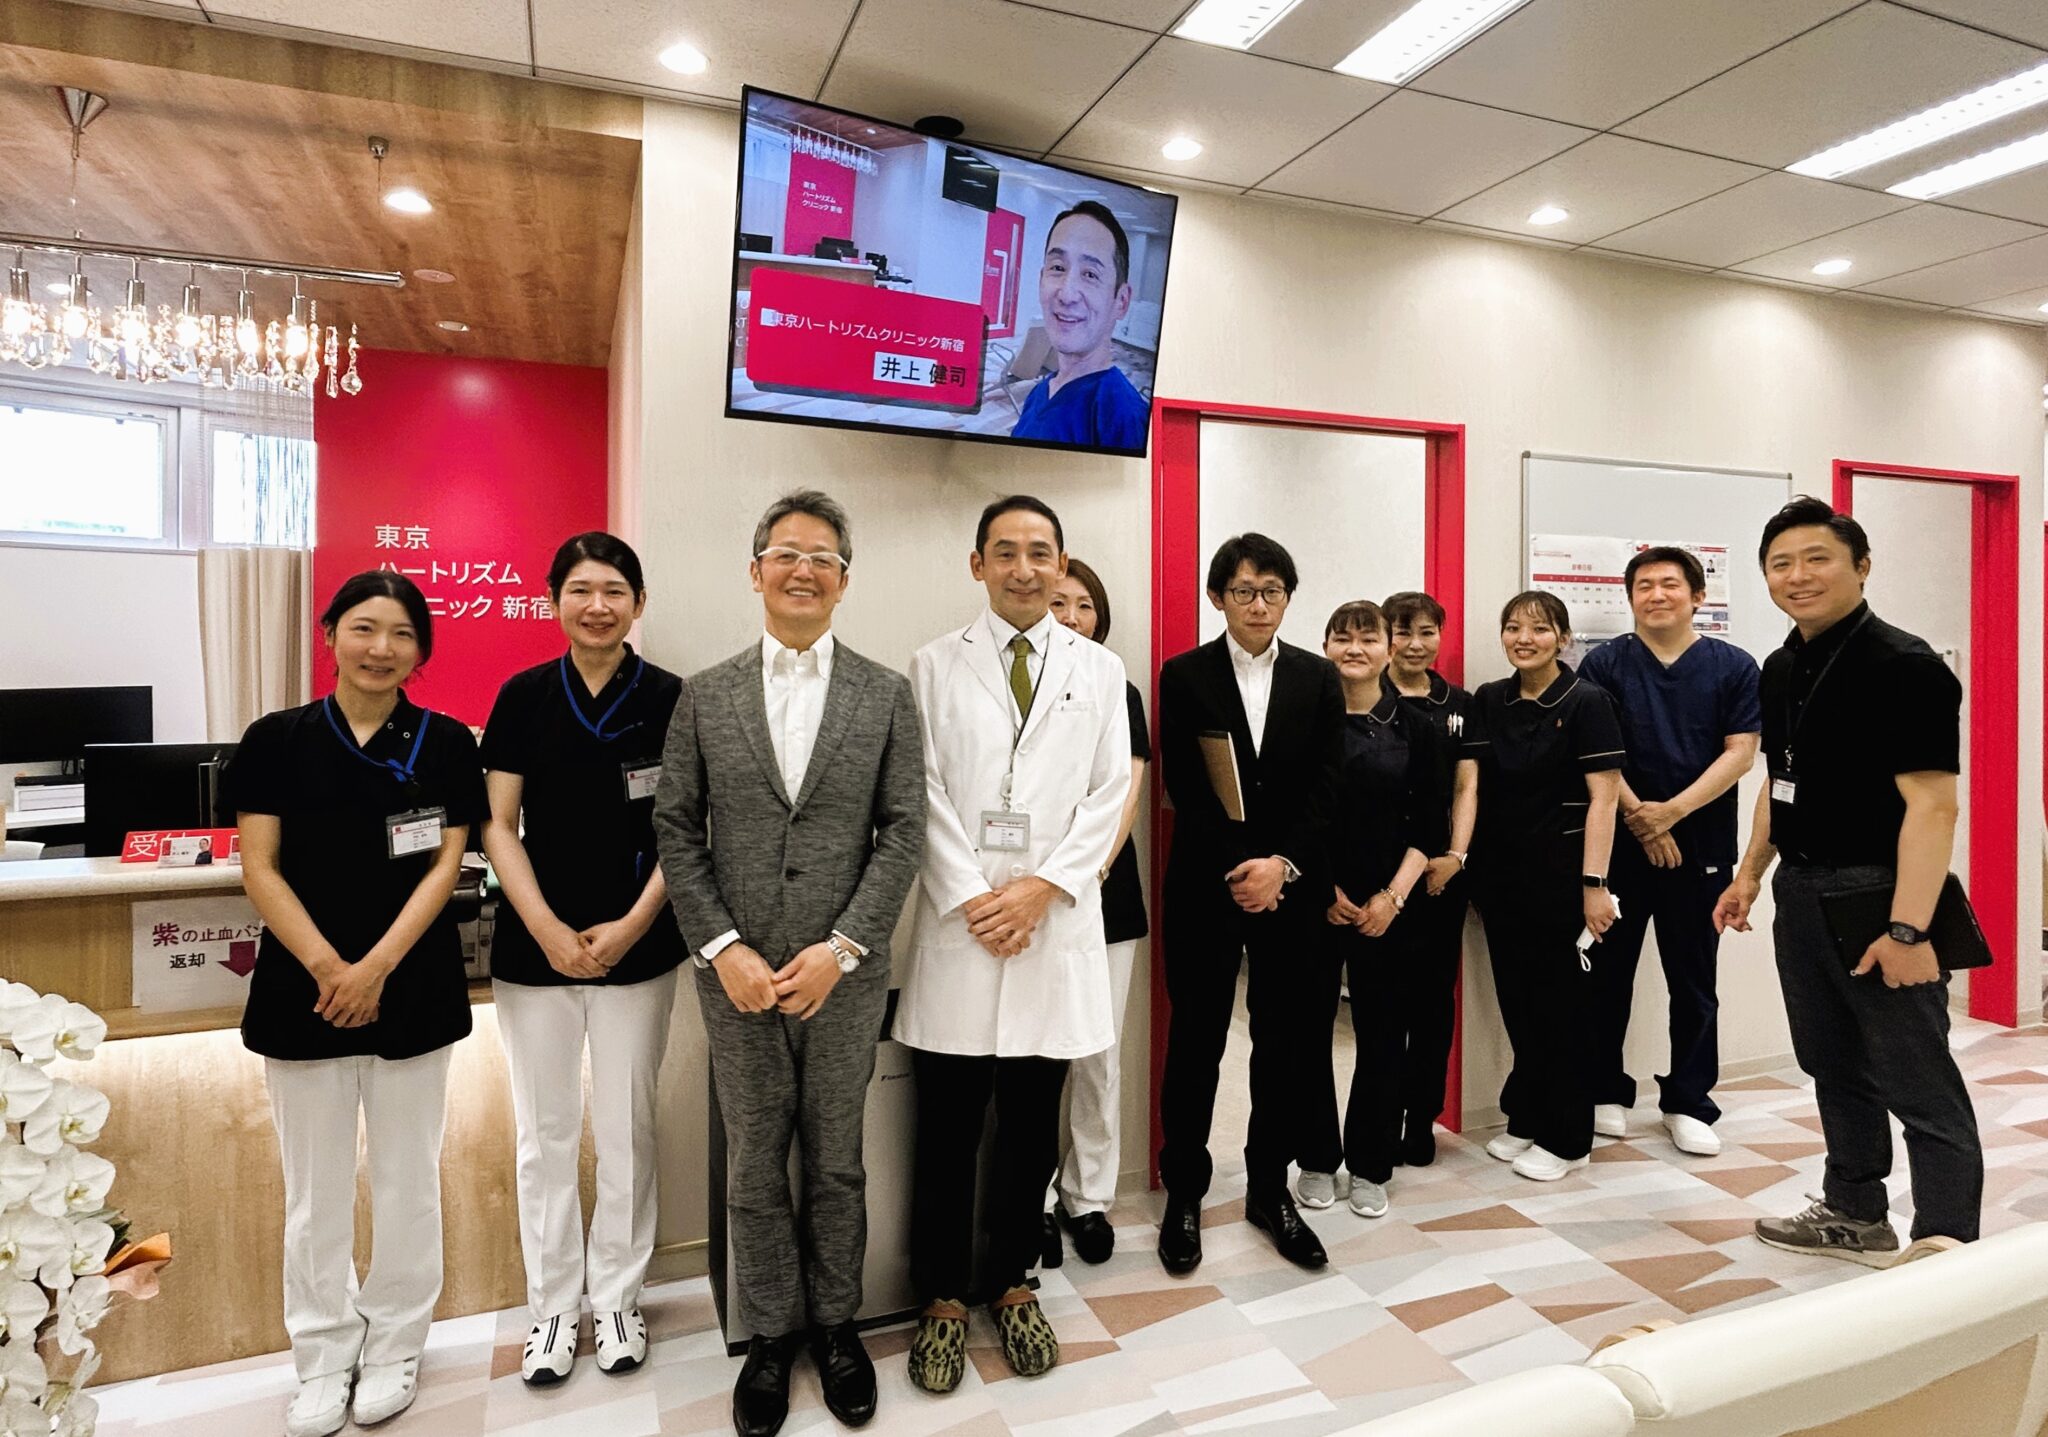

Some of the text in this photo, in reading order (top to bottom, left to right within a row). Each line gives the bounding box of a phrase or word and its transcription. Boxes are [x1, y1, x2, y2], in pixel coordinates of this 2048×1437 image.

[881, 356, 966, 388] 井上 健司
[374, 524, 430, 549] 東京
[425, 595, 553, 620] ニック 新宿
[169, 953, 206, 969] 返却
